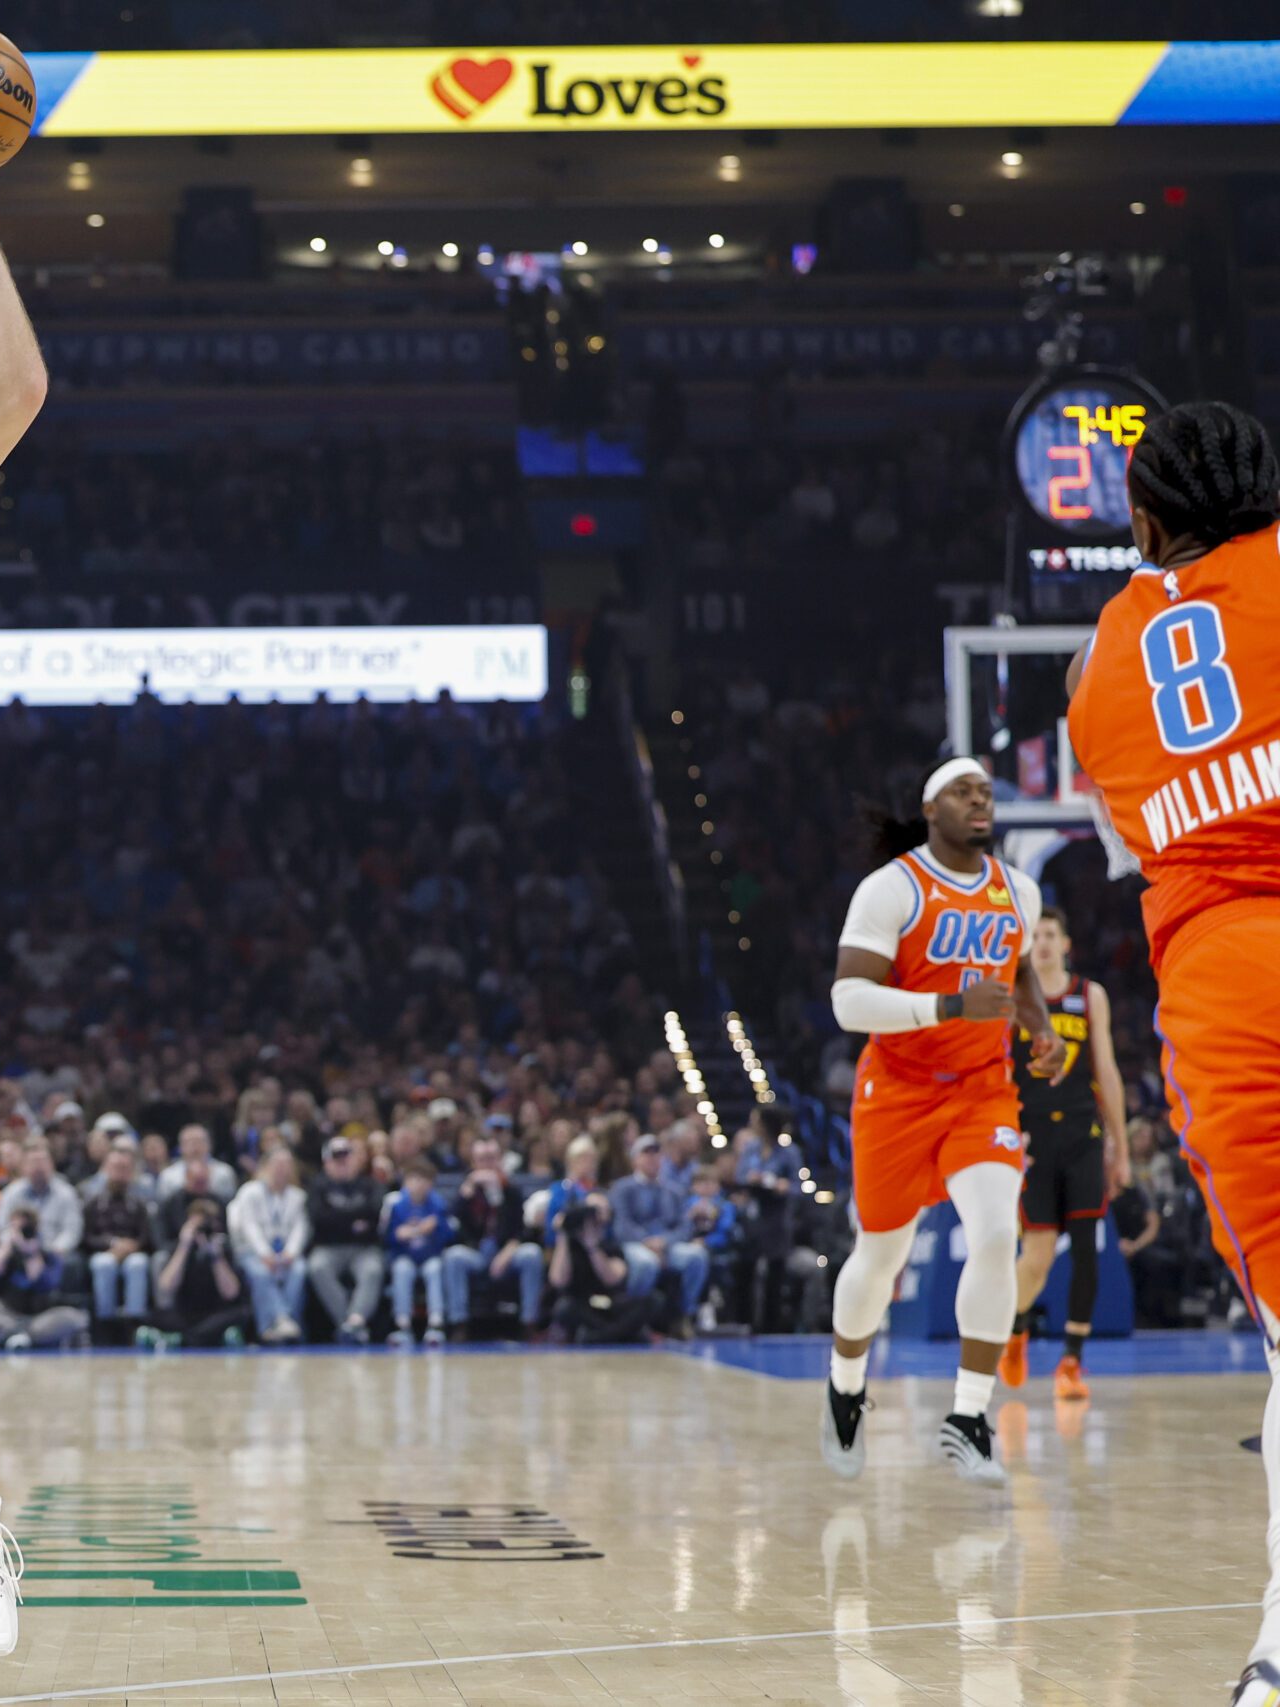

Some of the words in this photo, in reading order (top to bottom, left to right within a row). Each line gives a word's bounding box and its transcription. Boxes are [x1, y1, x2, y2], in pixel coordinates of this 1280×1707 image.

[1063, 405, 1146, 447] 7:45
[82, 641, 253, 684] Strategic
[1140, 600, 1242, 754] 8
[925, 907, 1018, 966] OKC
